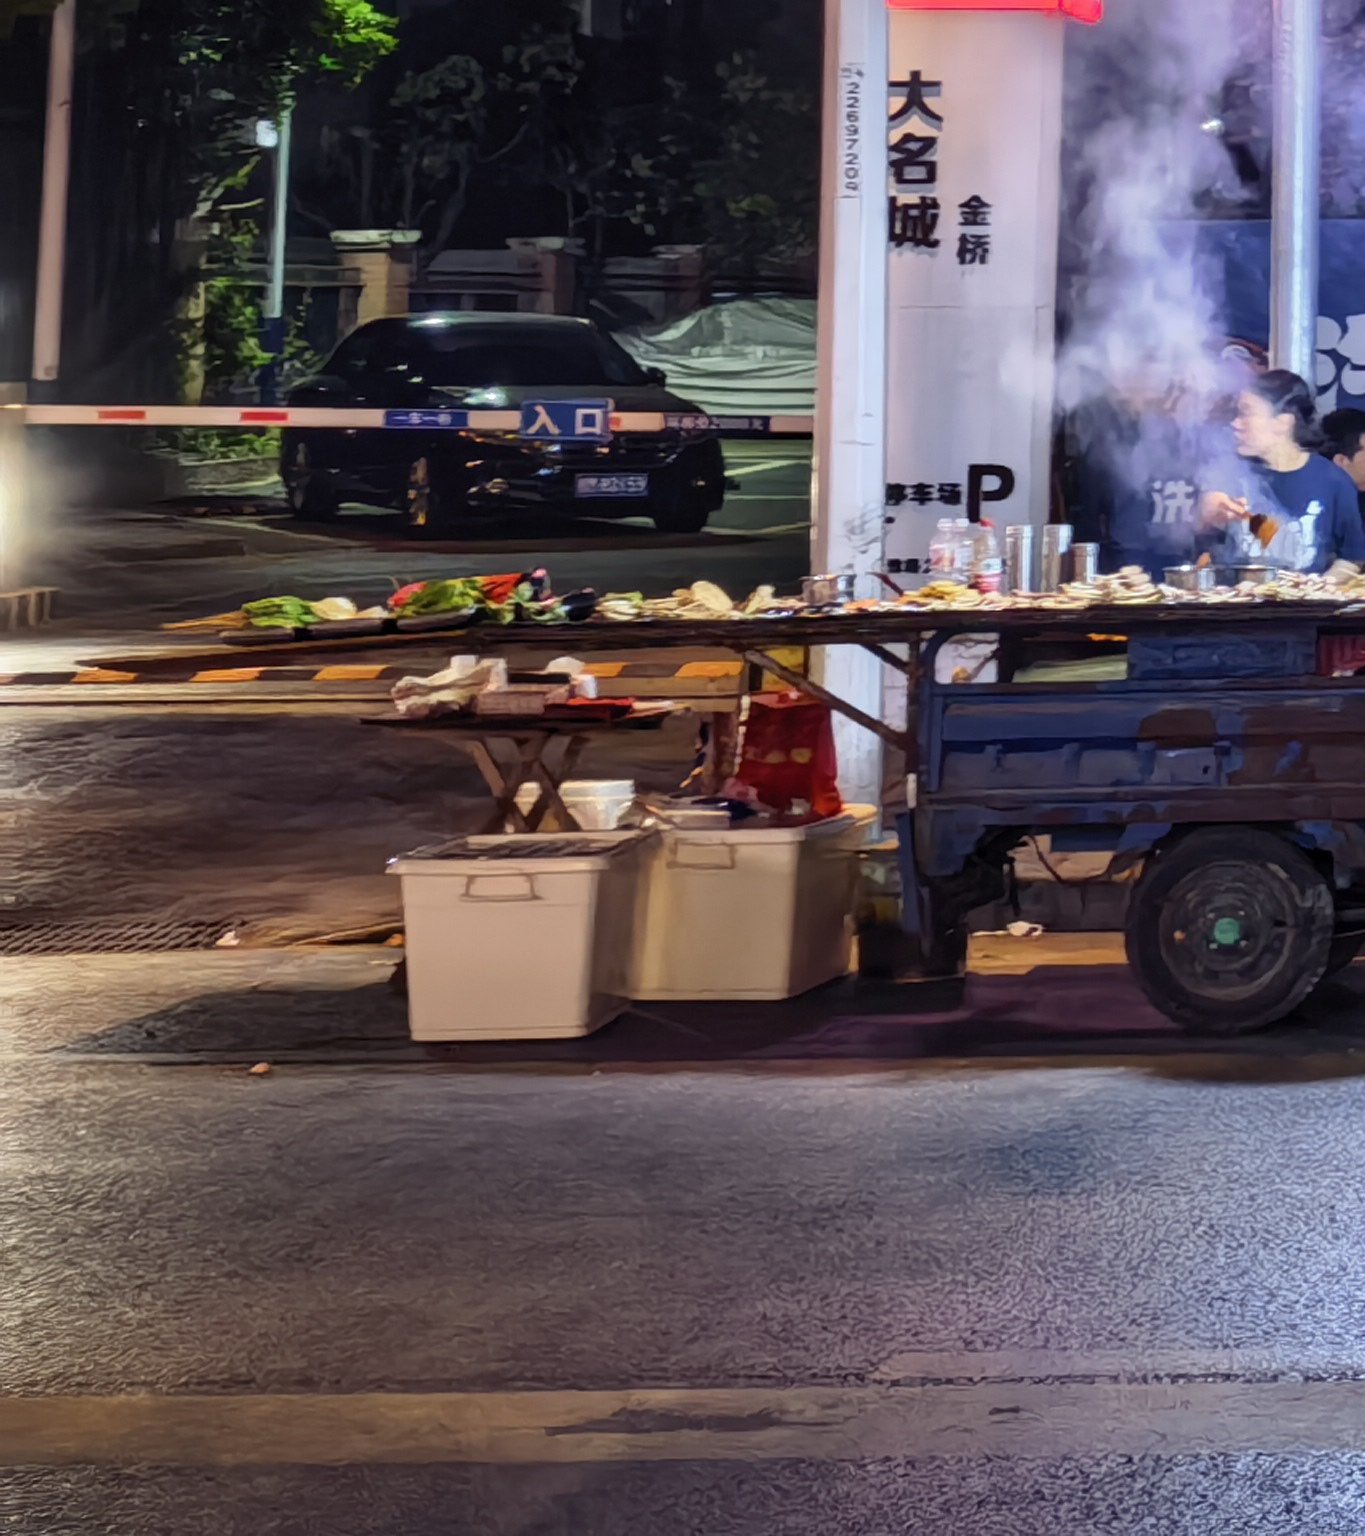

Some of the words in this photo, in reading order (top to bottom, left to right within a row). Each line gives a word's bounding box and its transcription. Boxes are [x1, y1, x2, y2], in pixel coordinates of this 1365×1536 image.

[888, 70, 943, 248] 大名城
[956, 194, 993, 264] 金桥
[526, 405, 604, 436] 入口
[967, 464, 1015, 523] P
